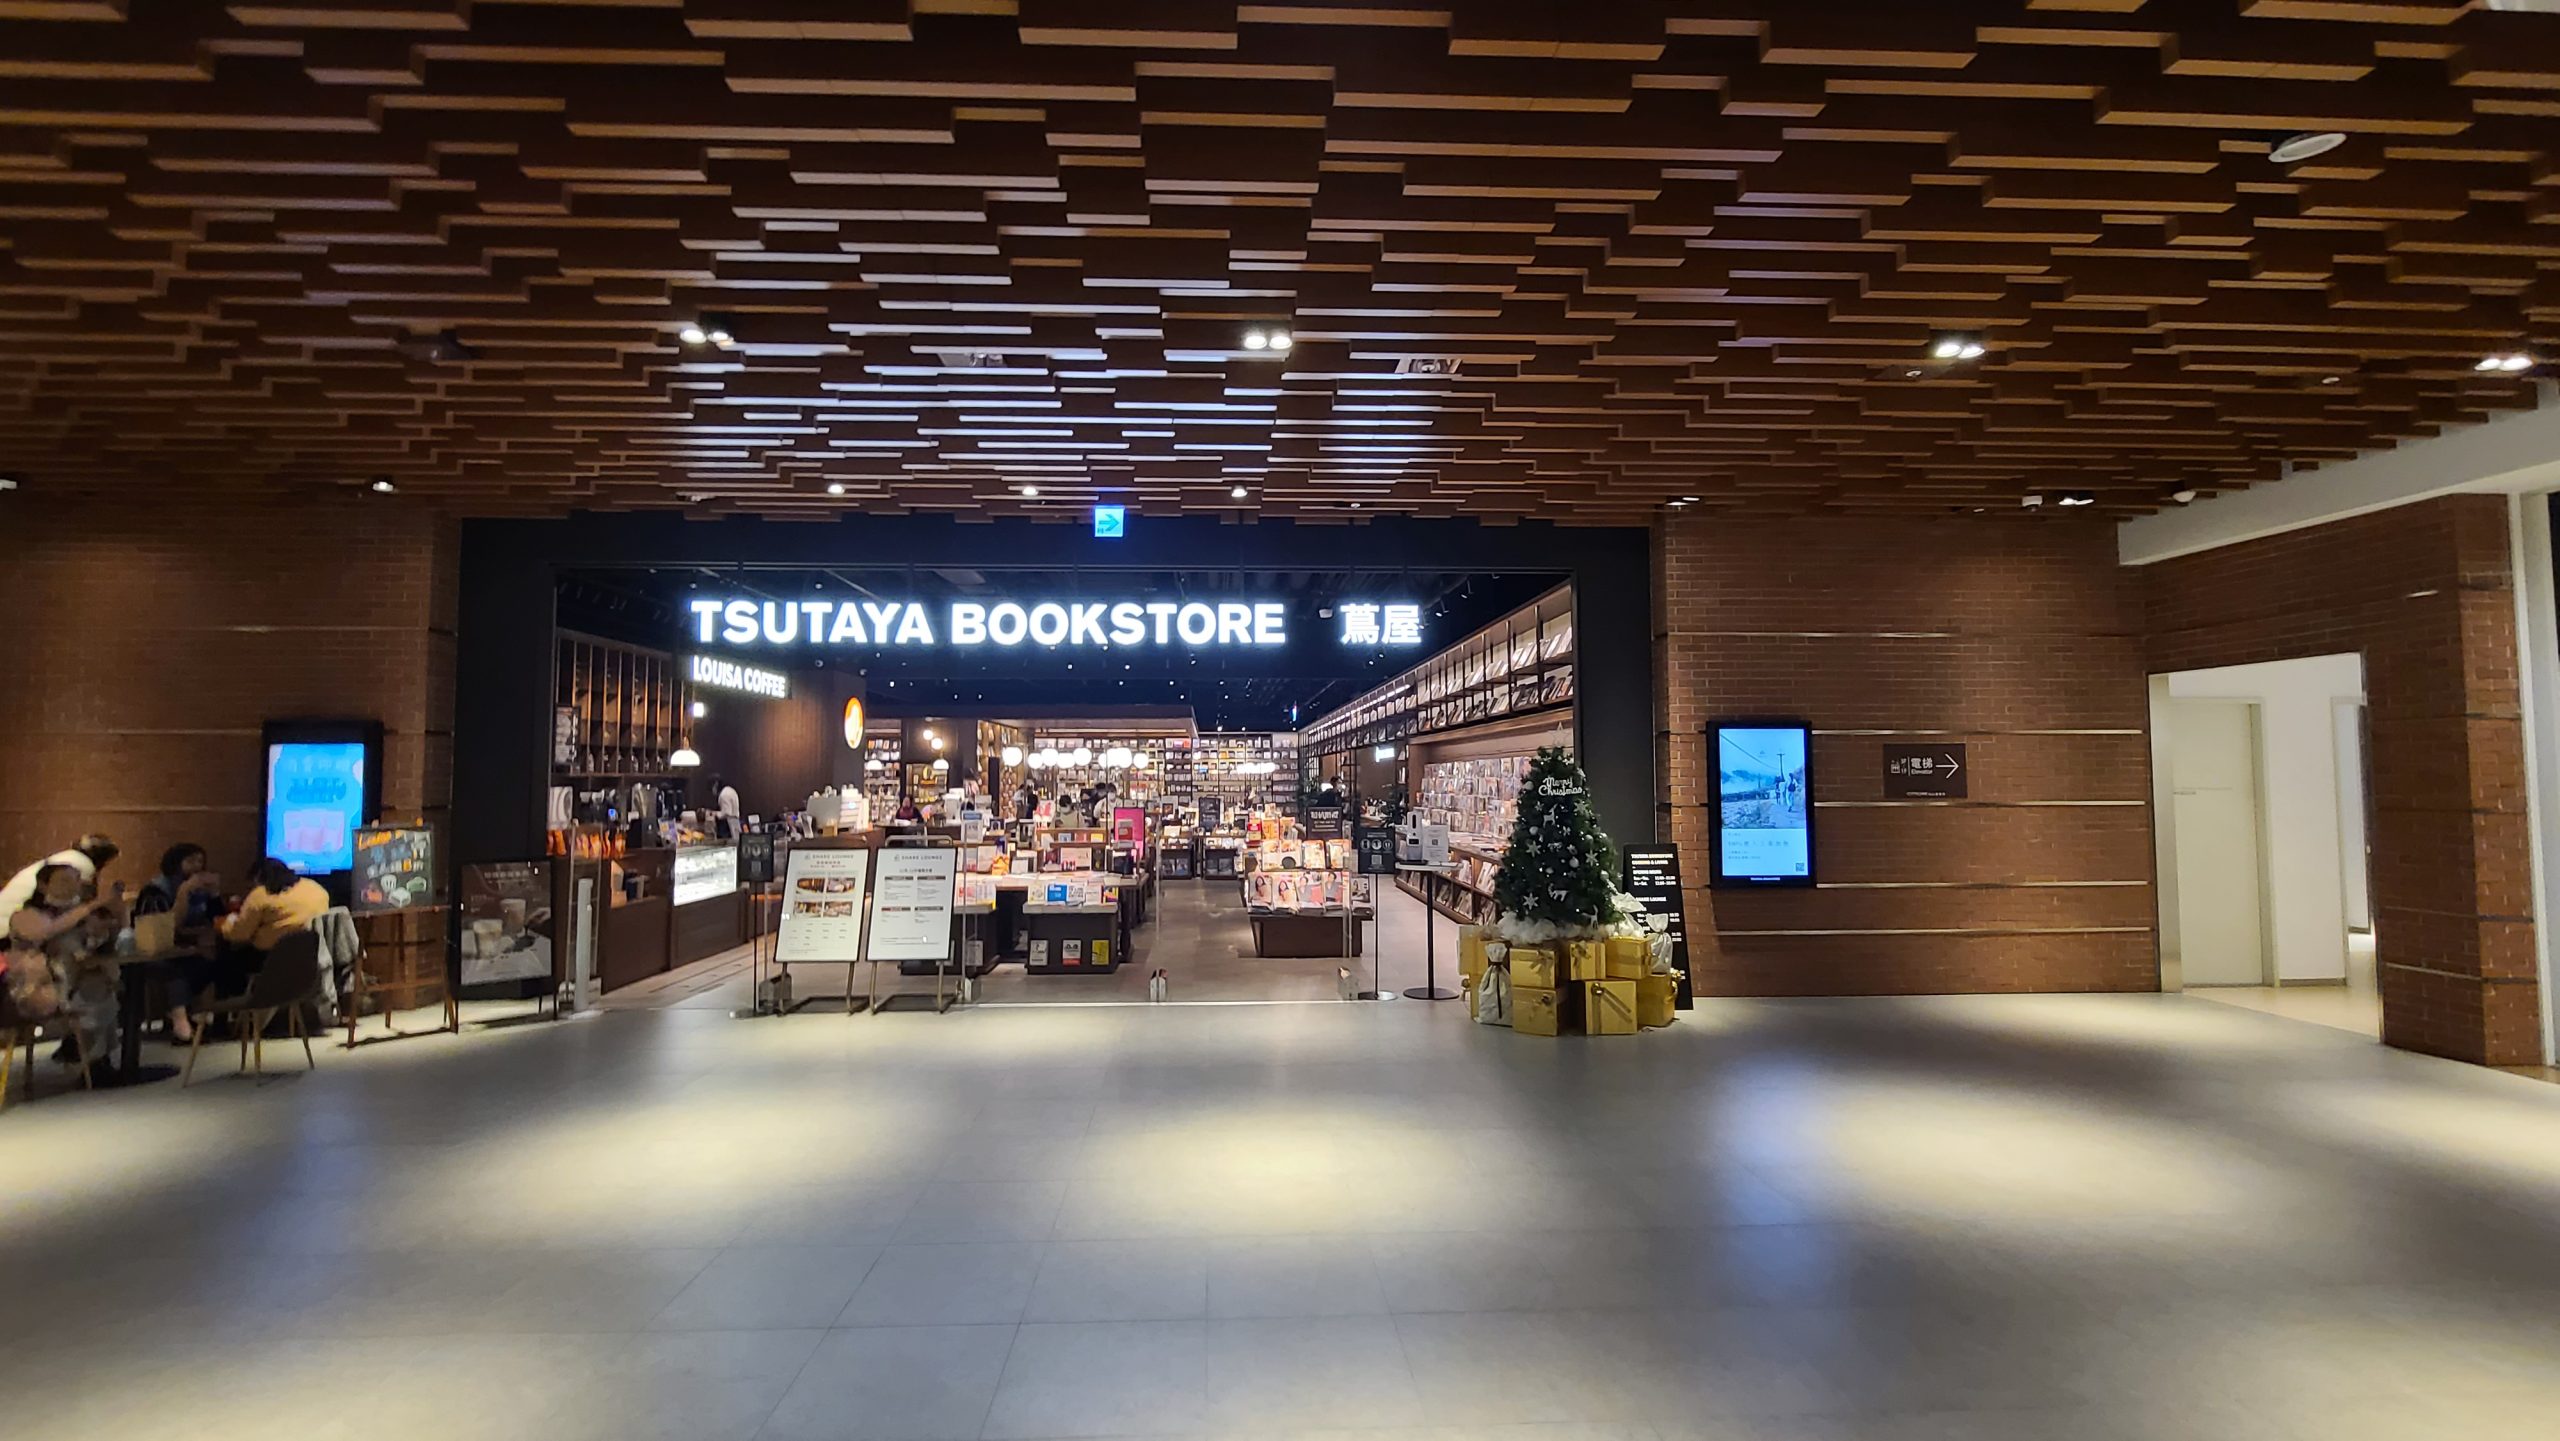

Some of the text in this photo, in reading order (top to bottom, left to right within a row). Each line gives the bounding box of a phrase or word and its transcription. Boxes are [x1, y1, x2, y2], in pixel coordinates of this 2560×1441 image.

[691, 601, 1286, 645] TSUTAYA BOOKSTORE
[1339, 603, 1423, 645] 蔦屋
[693, 654, 786, 699] LOUISA COFFEE
[1538, 784, 1583, 796] Christmas
[1542, 775, 1573, 790] Merry
